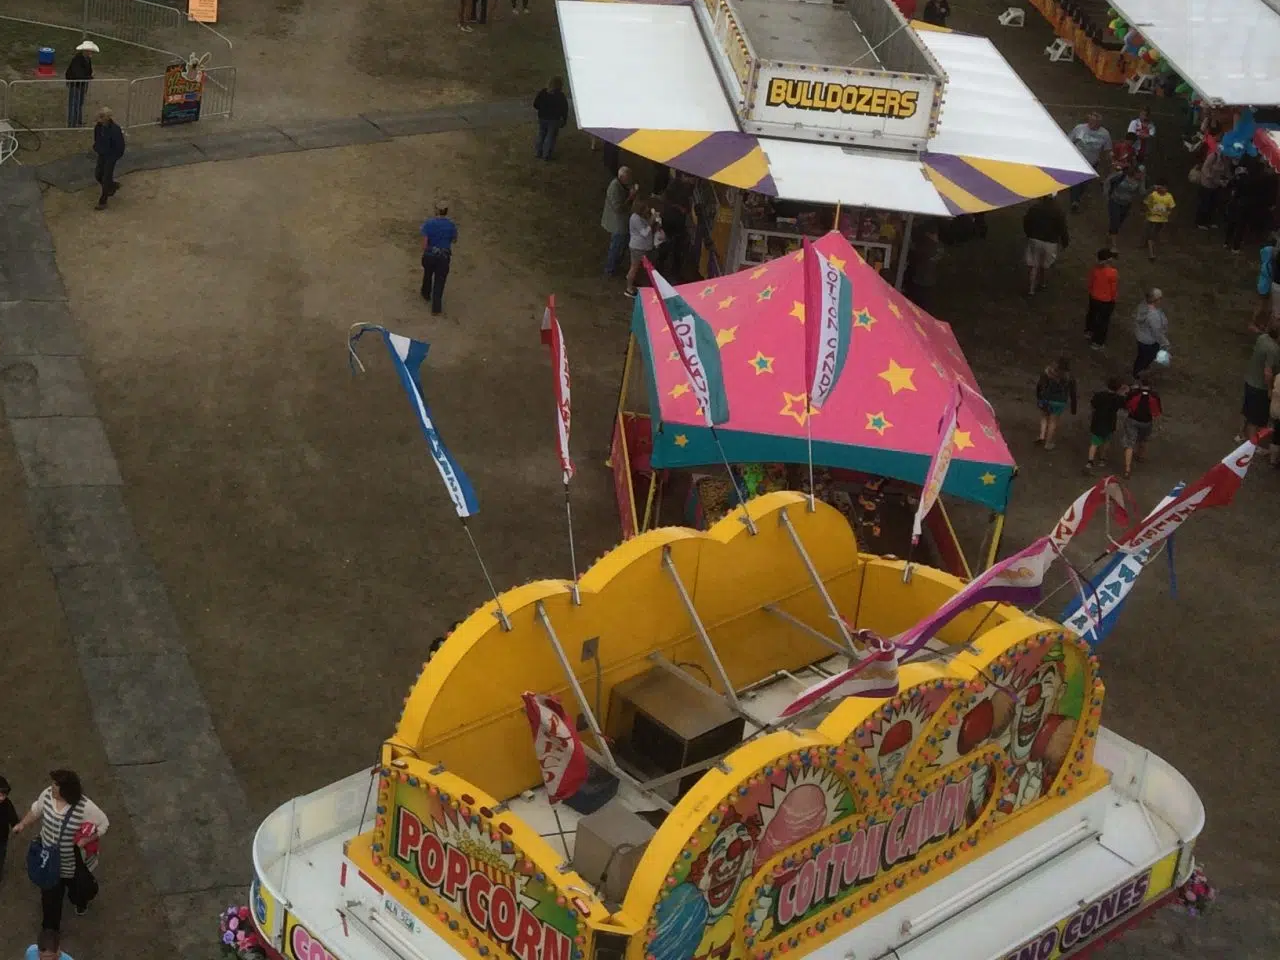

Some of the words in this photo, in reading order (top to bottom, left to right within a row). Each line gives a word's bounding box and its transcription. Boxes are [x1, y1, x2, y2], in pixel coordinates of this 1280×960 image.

[766, 77, 920, 119] BULLDOZERS
[818, 337, 837, 398] CANDY
[398, 806, 570, 960] POPCORN
[777, 823, 887, 926] COTTON
[885, 773, 972, 866] CANDY
[1007, 926, 1059, 960] NO
[1061, 872, 1151, 949] CONES
